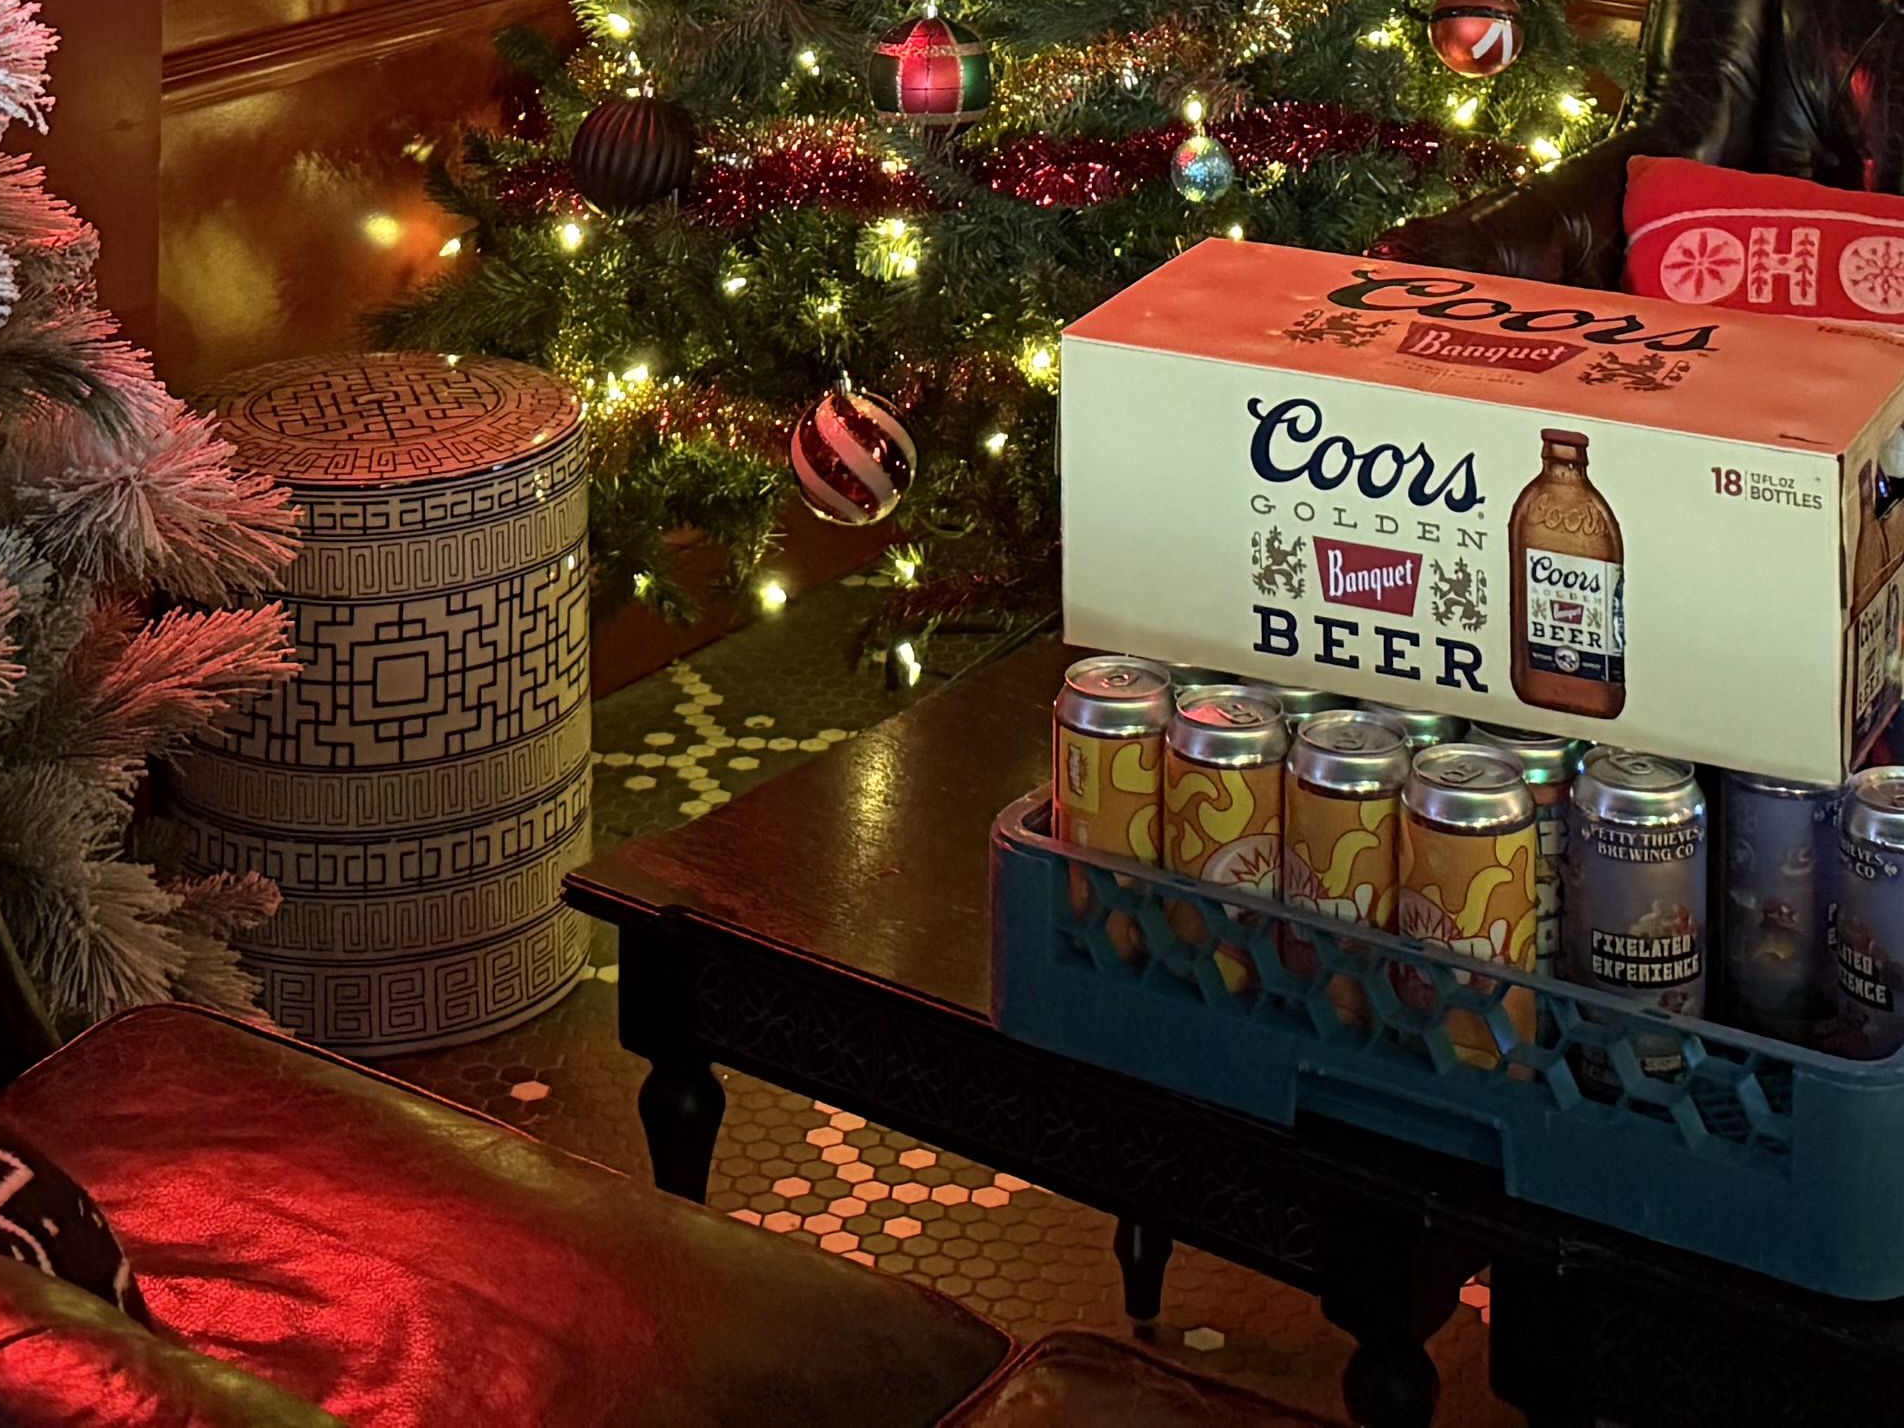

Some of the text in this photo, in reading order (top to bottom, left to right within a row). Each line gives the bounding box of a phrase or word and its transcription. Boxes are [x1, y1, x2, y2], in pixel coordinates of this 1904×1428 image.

[1327, 269, 1720, 352] Coors
[1408, 329, 1569, 363] Banquet
[1247, 397, 1486, 513] Coors
[1711, 466, 1743, 496] 18
[1750, 485, 1823, 510] BOTTLES
[1251, 494, 1488, 551] GOLDEN
[1327, 549, 1414, 602] Banquet
[1530, 555, 1601, 593] Coors
[1253, 603, 1489, 693] BEER
[1532, 620, 1602, 649] BEER
[1597, 841, 1695, 863] BREWING CO
[1591, 930, 1692, 959] PIXELATED
[1591, 952, 1700, 983] EXPERIENCE
